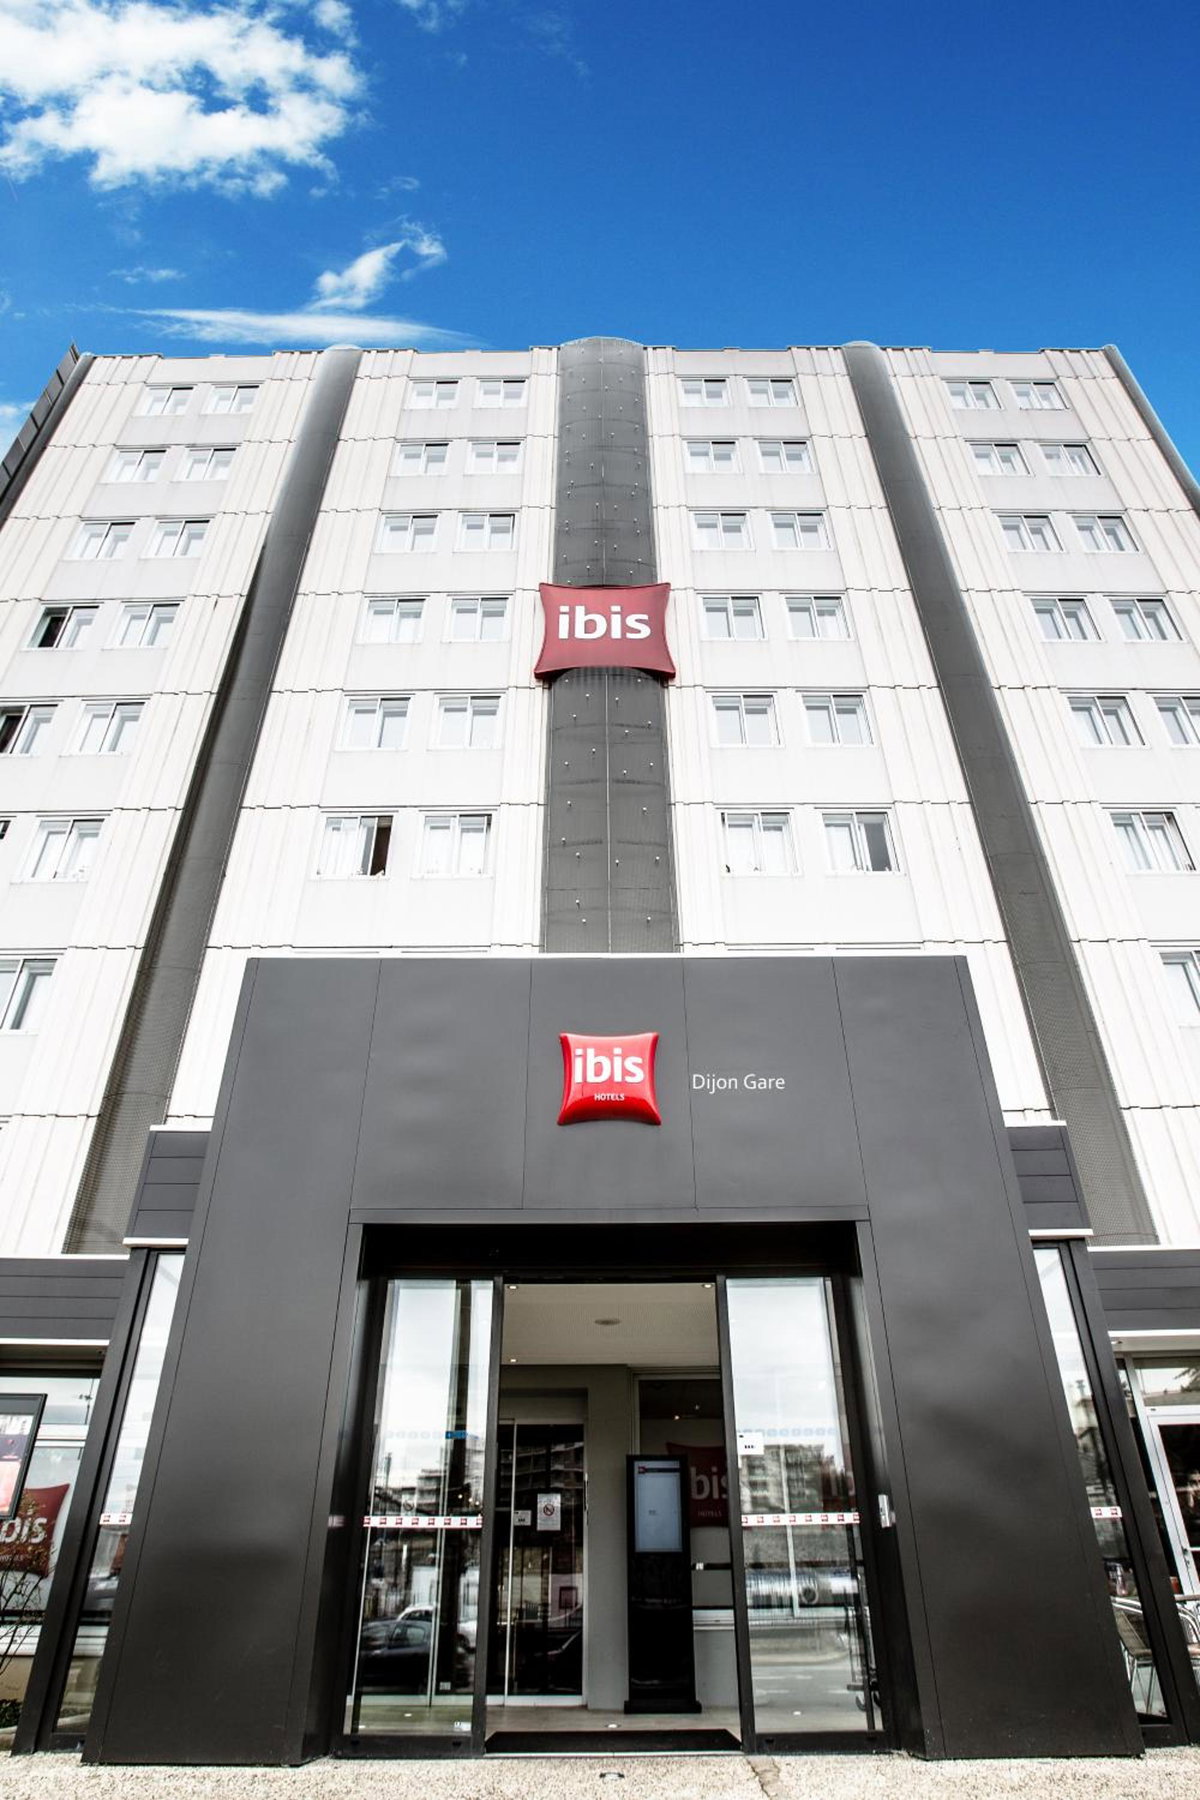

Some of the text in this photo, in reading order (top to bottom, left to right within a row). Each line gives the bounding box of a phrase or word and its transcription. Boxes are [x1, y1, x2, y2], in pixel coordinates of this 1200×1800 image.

[558, 605, 652, 640] ibis
[574, 1048, 645, 1083] ibis
[594, 1093, 625, 1101] HOTELS
[692, 1073, 786, 1094] Dijon Gare
[690, 1466, 728, 1500] bi
[0, 1508, 47, 1544] bis
